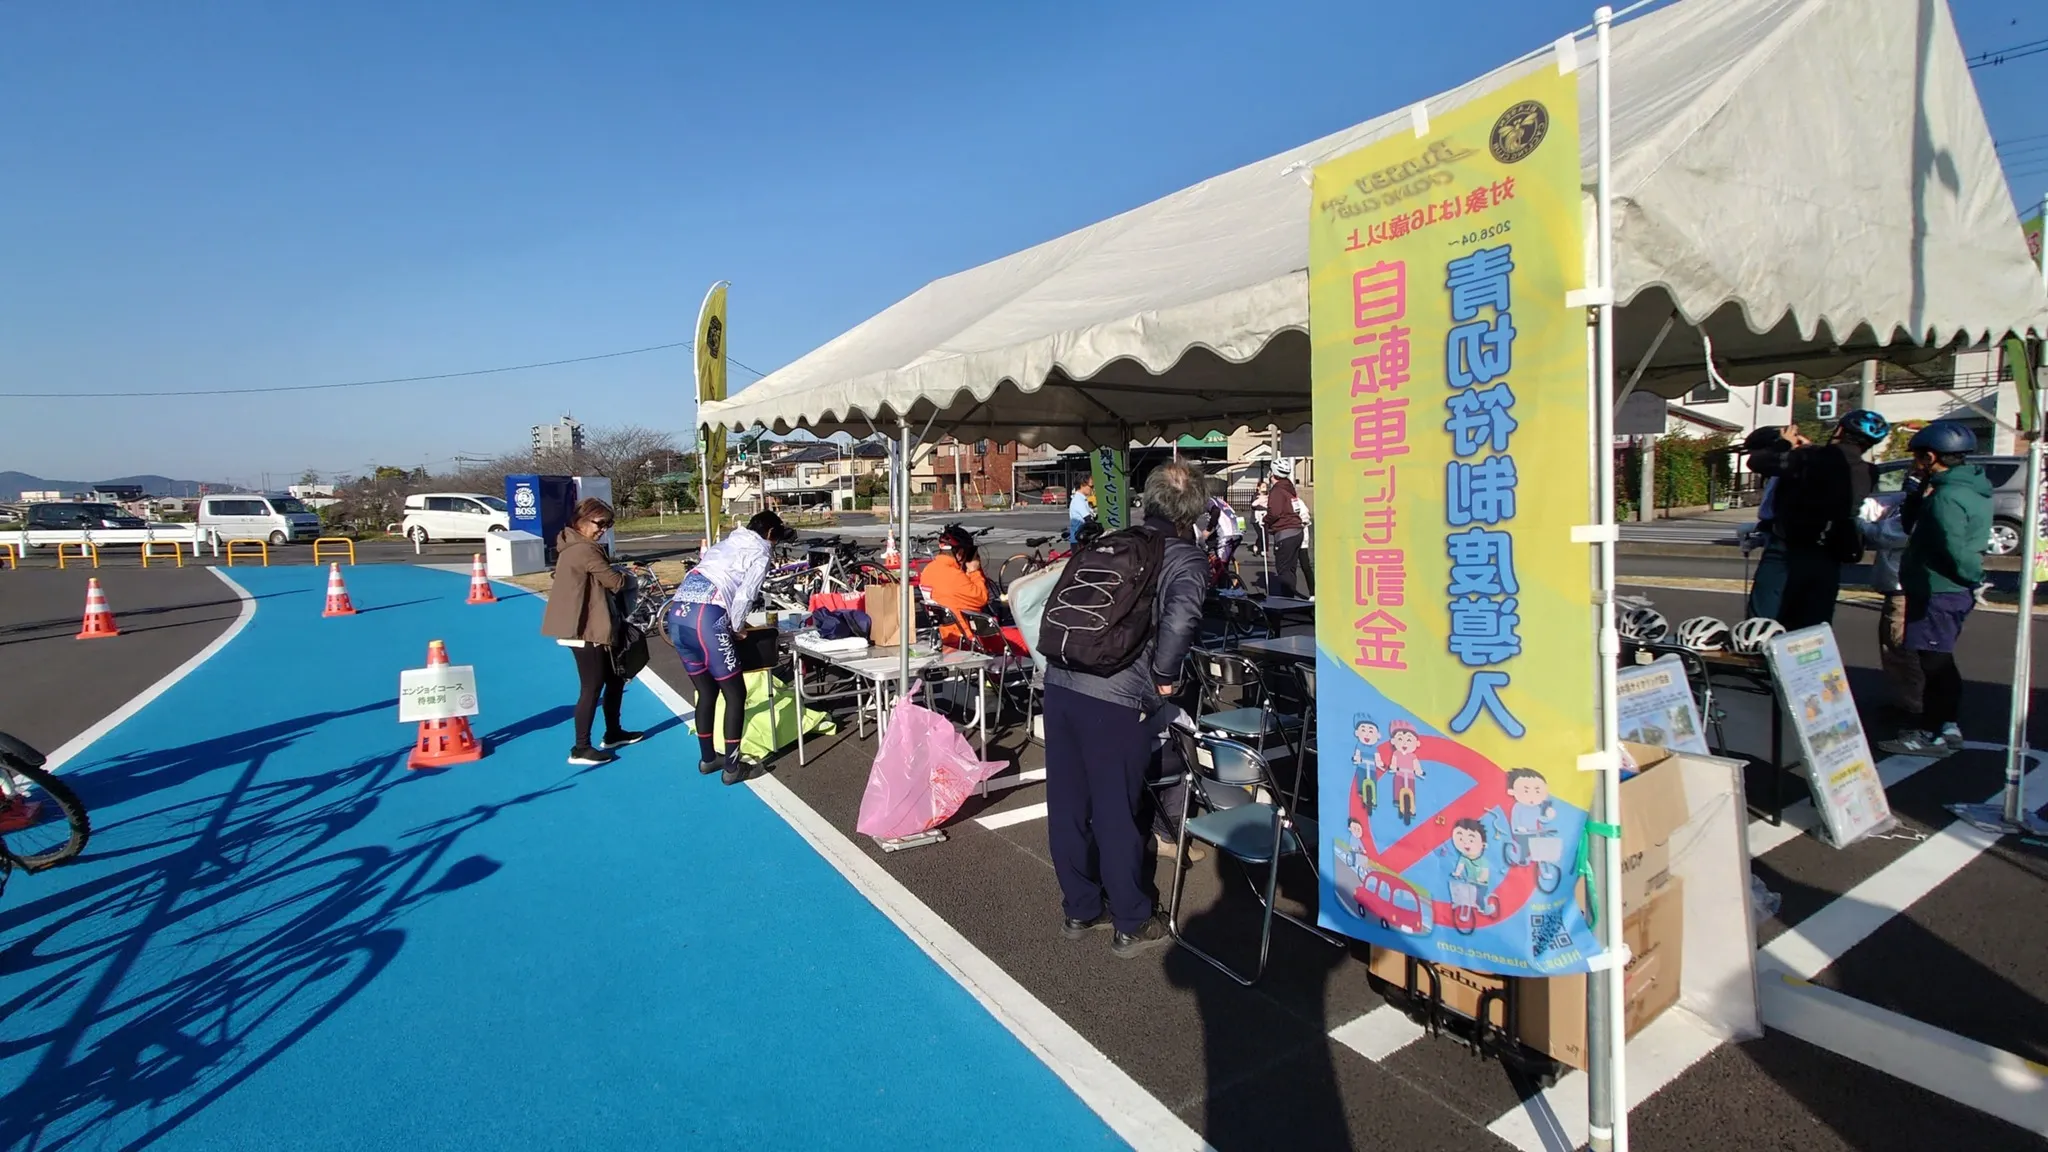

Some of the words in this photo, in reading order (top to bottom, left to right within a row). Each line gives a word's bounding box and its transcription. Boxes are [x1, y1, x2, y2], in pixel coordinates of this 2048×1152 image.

[515, 507, 536, 515] BOSS
[402, 683, 465, 696] エンジョイコース
[417, 694, 447, 706] 待機列
